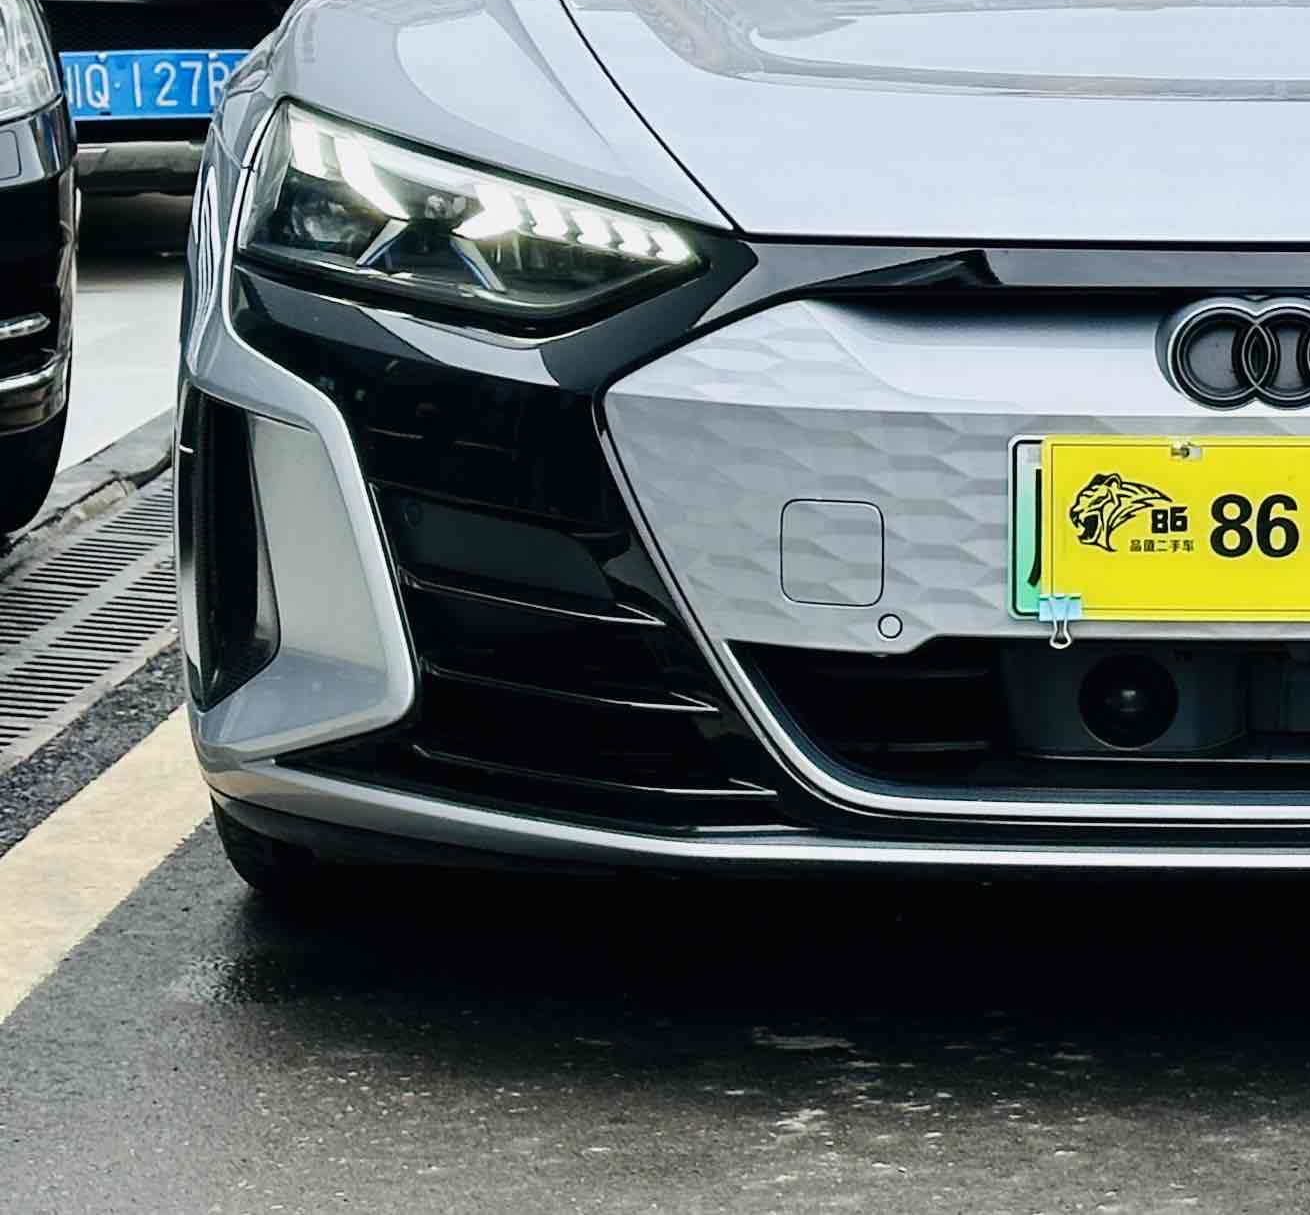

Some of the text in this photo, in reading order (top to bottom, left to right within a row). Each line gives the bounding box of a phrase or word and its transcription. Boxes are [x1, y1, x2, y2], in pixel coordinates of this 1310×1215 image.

[1151, 506, 1188, 534] 86
[1129, 539, 1195, 553] 品值二手车
